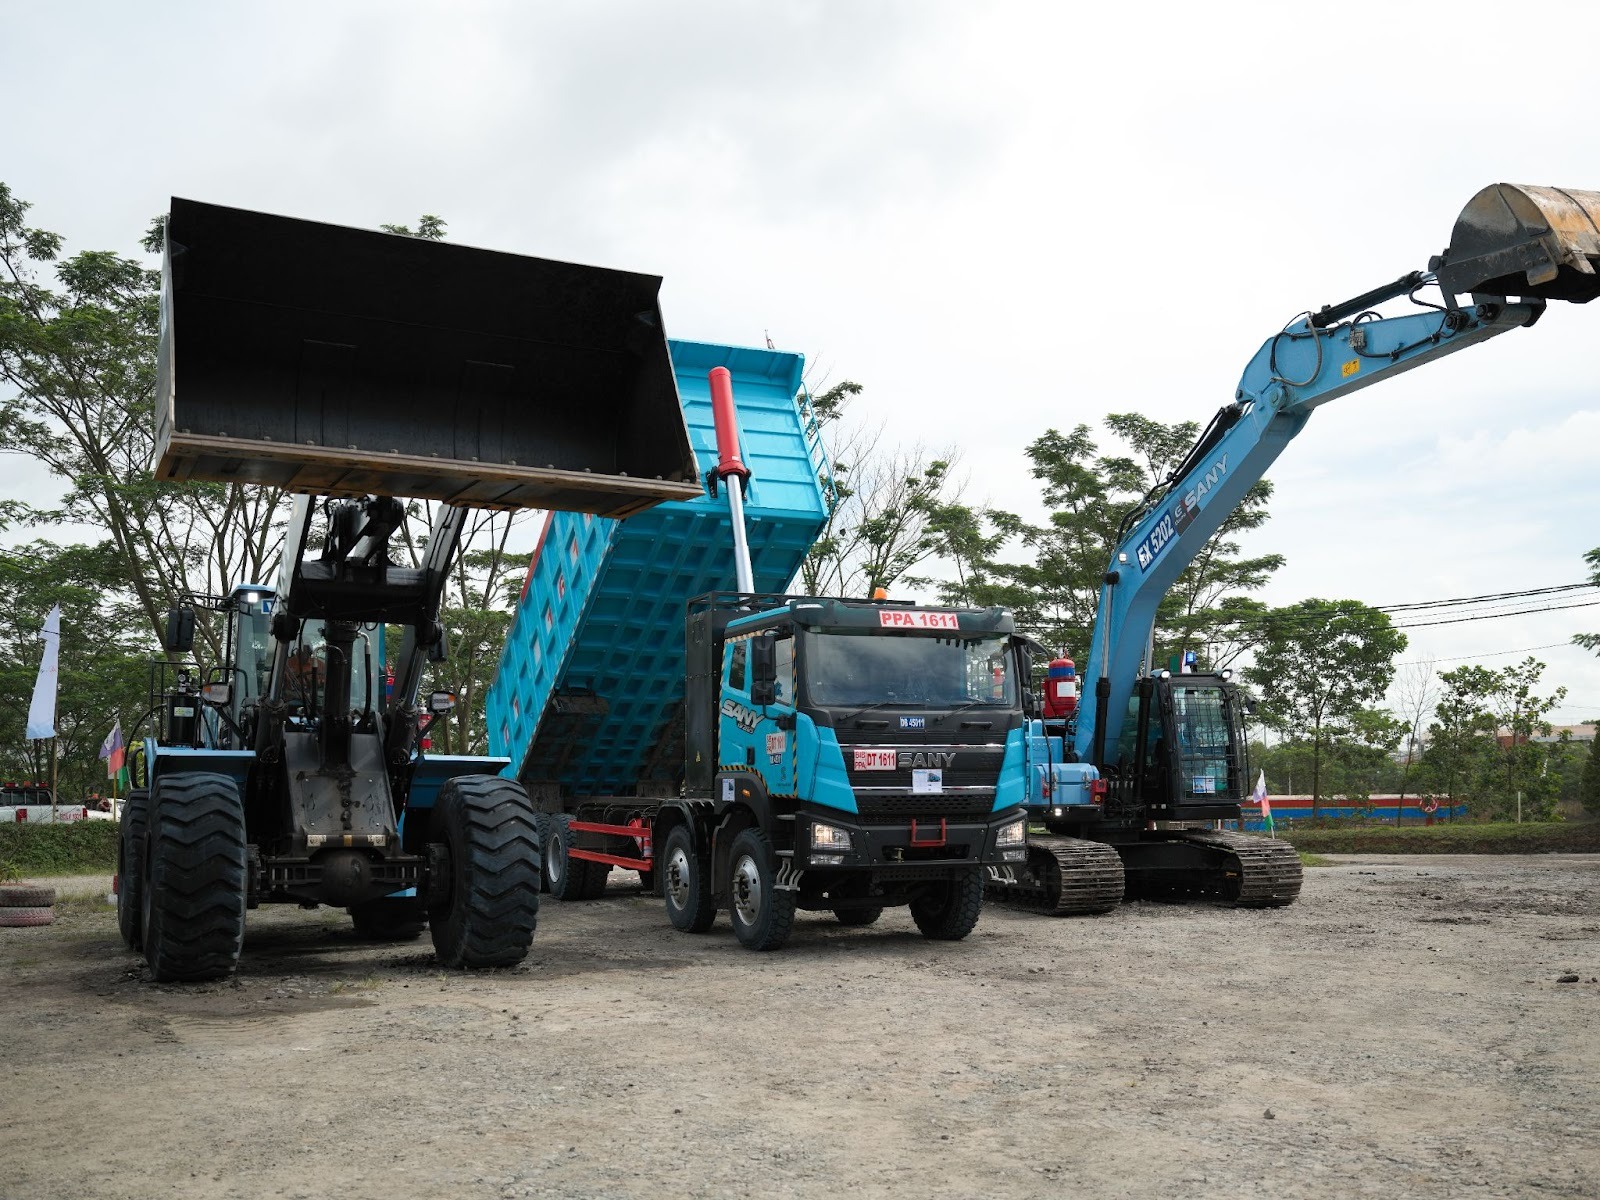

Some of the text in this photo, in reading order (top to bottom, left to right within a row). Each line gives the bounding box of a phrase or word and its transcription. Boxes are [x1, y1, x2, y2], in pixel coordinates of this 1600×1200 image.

[1185, 453, 1228, 513] SANY
[1137, 514, 1175, 569] EX 5202
[881, 613, 957, 627] PPA 1611
[721, 699, 765, 729] SANY
[867, 753, 895, 766] DT 1611
[898, 752, 956, 768] SANY
